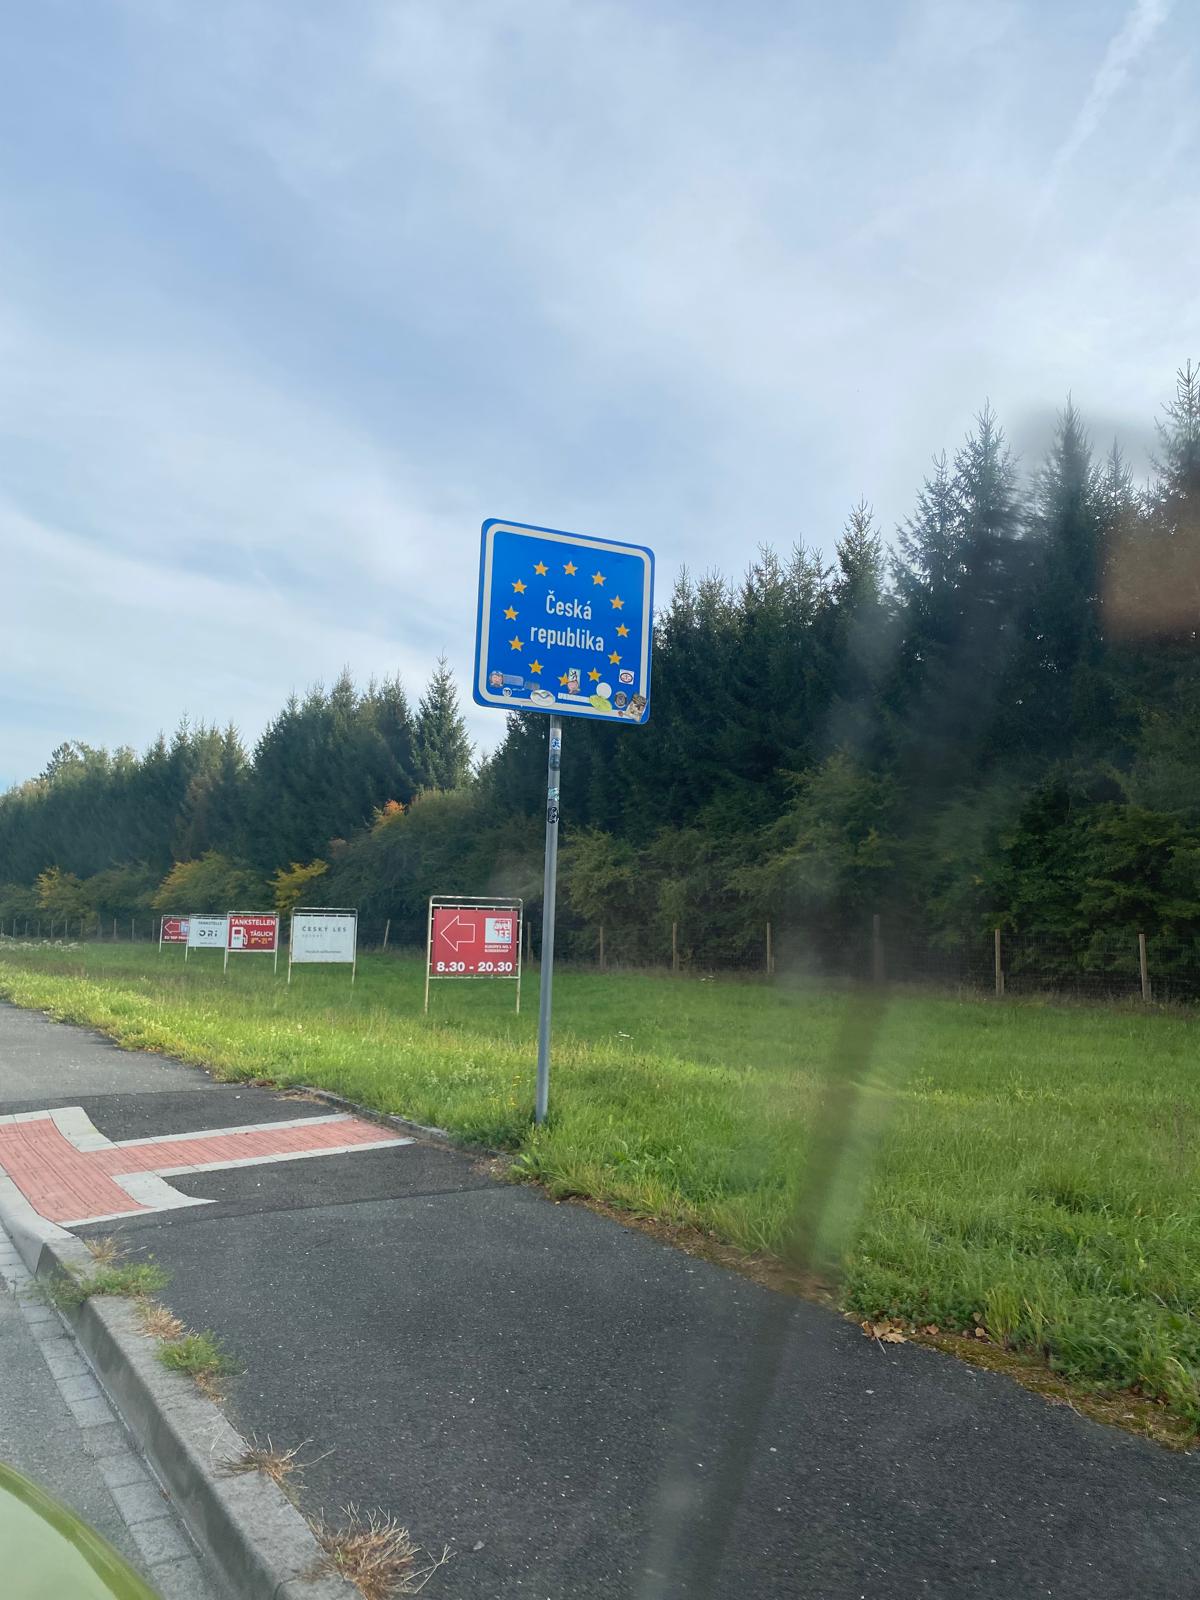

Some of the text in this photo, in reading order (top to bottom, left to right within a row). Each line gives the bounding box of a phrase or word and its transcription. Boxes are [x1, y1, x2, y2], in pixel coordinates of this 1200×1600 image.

[545, 590, 592, 620] Česká
[530, 626, 604, 652] republika
[231, 918, 276, 926] TANKSTELLEN
[436, 961, 466, 972] 8.30
[478, 961, 512, 972] 20.30
